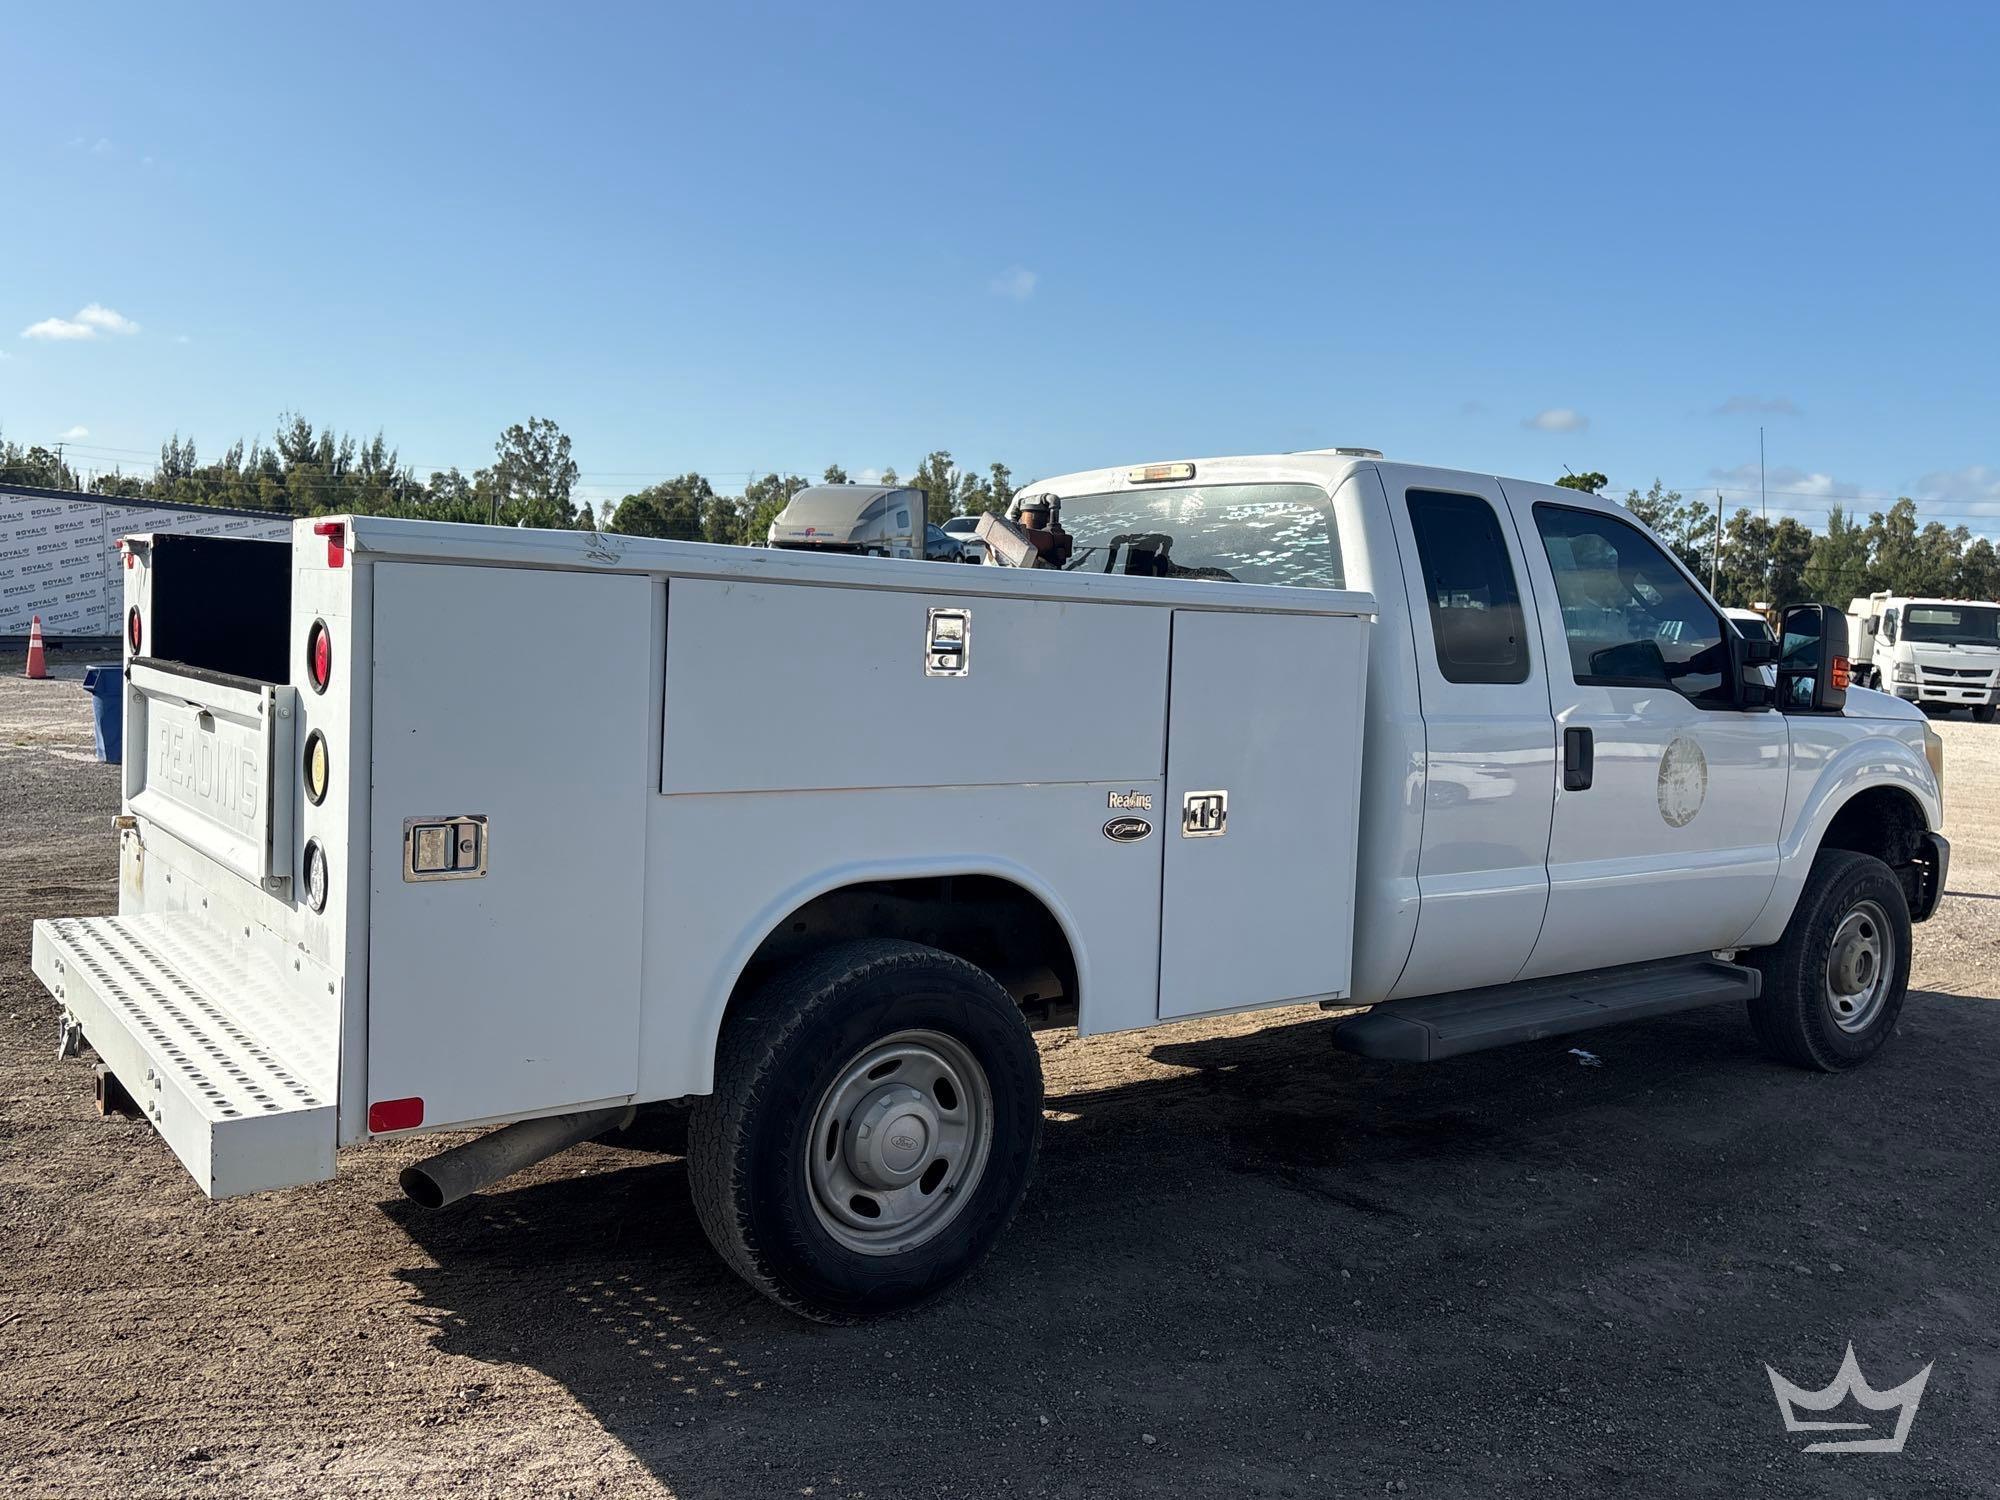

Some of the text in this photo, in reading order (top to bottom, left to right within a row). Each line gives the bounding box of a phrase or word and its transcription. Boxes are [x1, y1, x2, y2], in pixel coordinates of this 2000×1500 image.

[31, 507, 54, 516] ROYAL
[55, 521, 77, 531] ROYAL
[16, 528, 40, 537] ROYAL
[75, 536, 97, 545] ROYAL
[37, 542, 61, 552] ROYAL
[60, 556, 82, 565] ROYAL
[22, 563, 45, 573] ROYAL
[43, 578, 66, 587] ROYAL
[4, 585, 28, 595] ROYAL
[66, 591, 89, 600] ROYAL
[28, 599, 52, 609] ROYAL
[49, 612, 72, 622] ROYAL
[159, 718, 258, 820] READING
[1108, 790, 1152, 811] Reading
